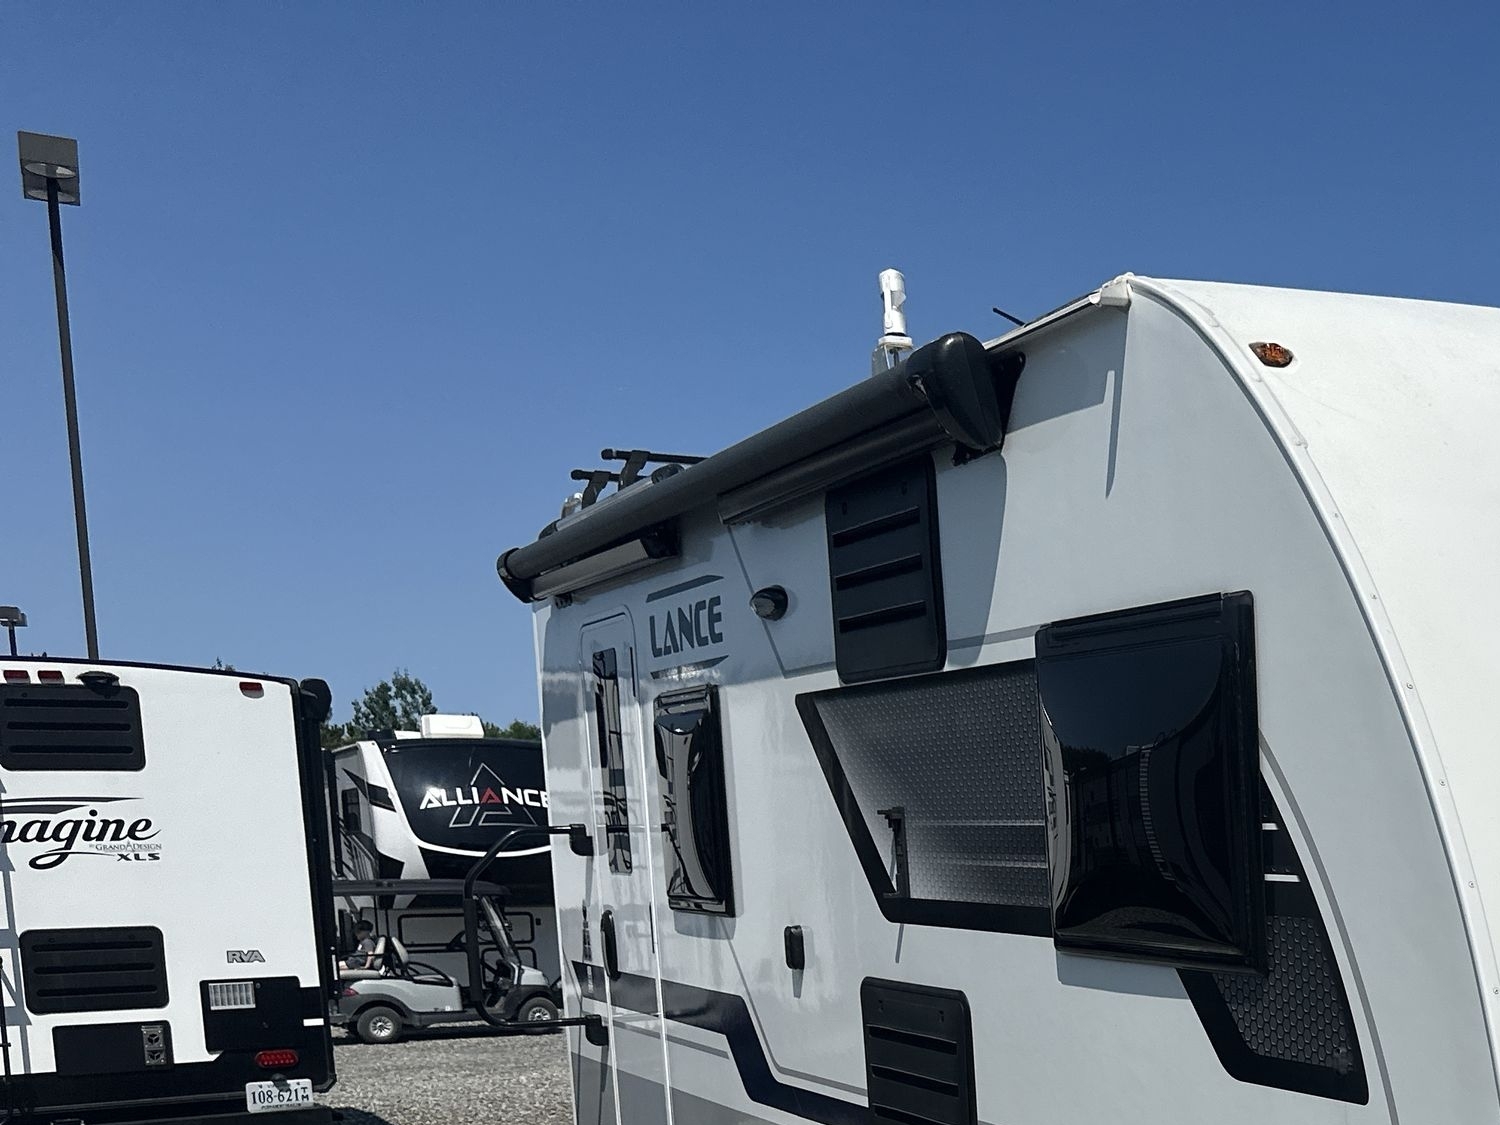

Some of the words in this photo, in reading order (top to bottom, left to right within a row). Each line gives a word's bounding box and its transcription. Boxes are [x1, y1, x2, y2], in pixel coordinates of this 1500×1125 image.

[649, 595, 724, 658] LANCE
[117, 852, 161, 862] XLS
[226, 949, 266, 963] RVA
[251, 1087, 299, 1105] 108-621
